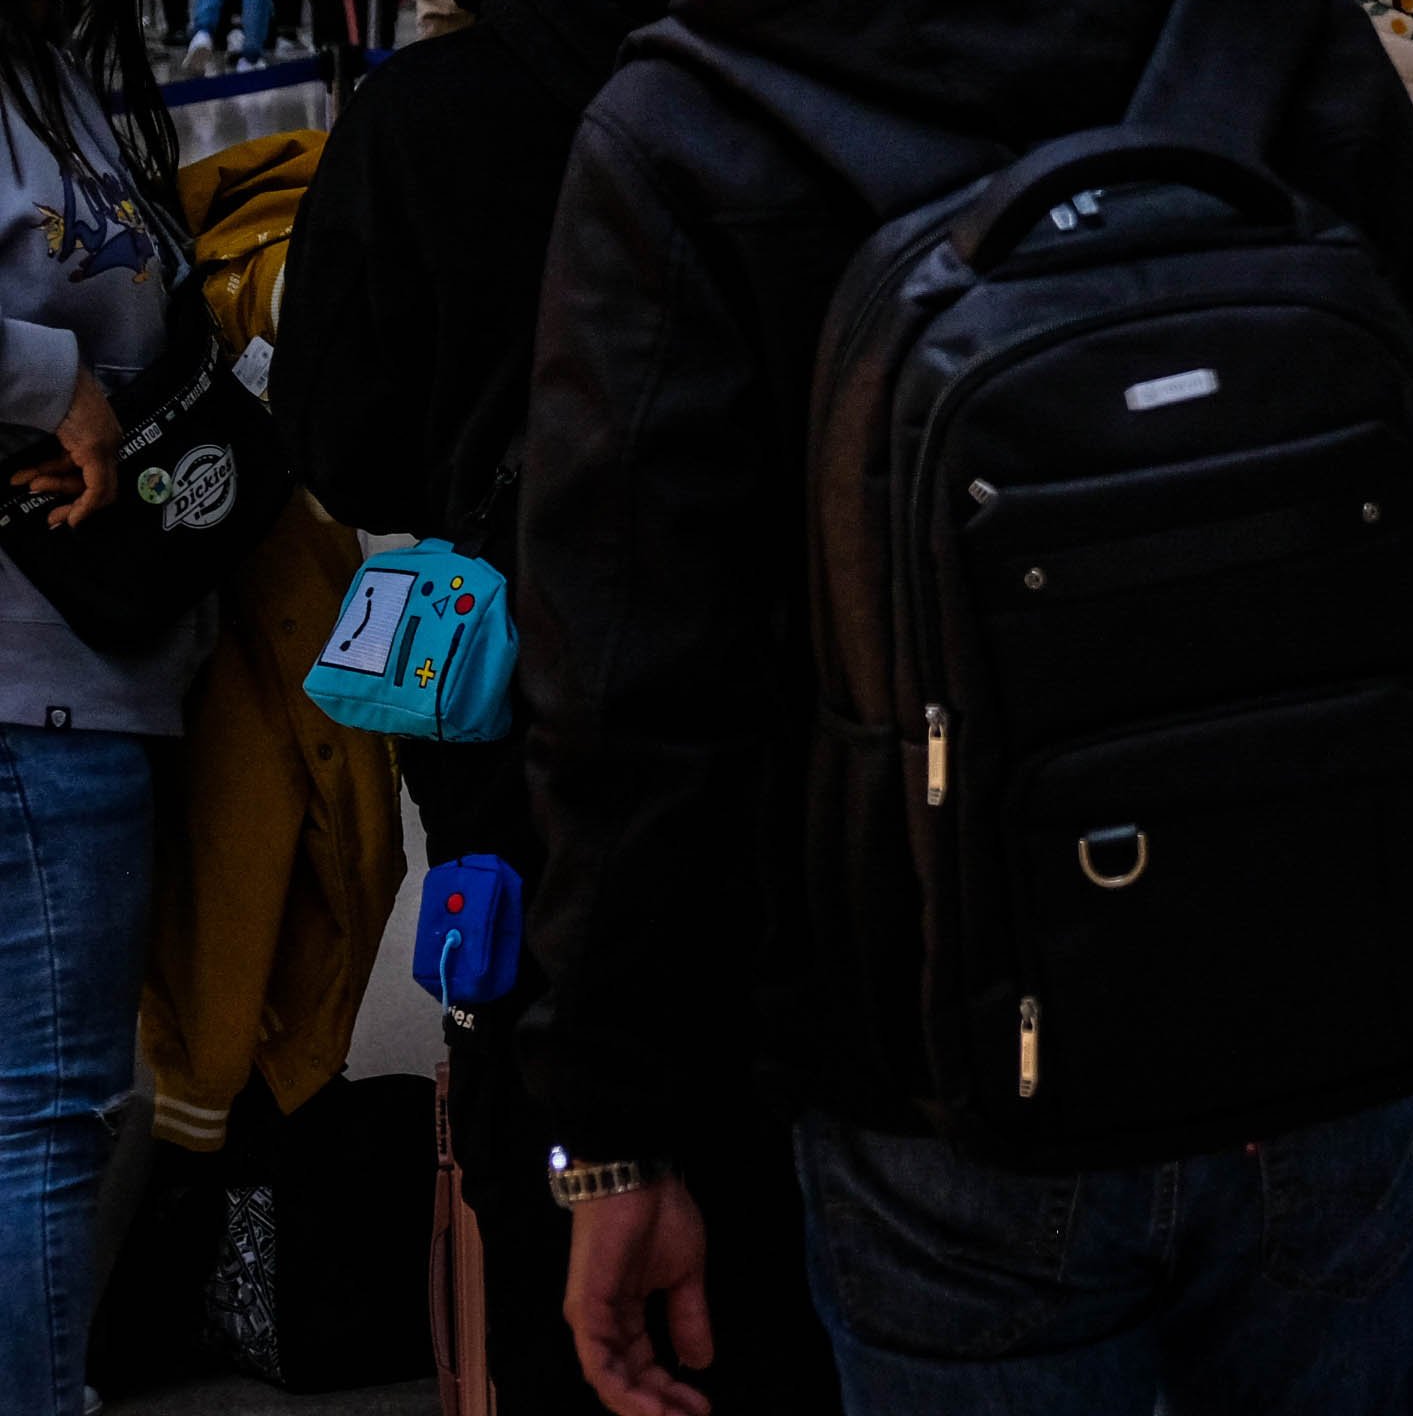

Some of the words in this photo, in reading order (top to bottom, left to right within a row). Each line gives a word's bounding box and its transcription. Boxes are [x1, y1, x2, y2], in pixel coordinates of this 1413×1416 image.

[117, 435, 147, 462] CKIES
[144, 424, 162, 444] 100
[174, 456, 233, 518] Dickies
